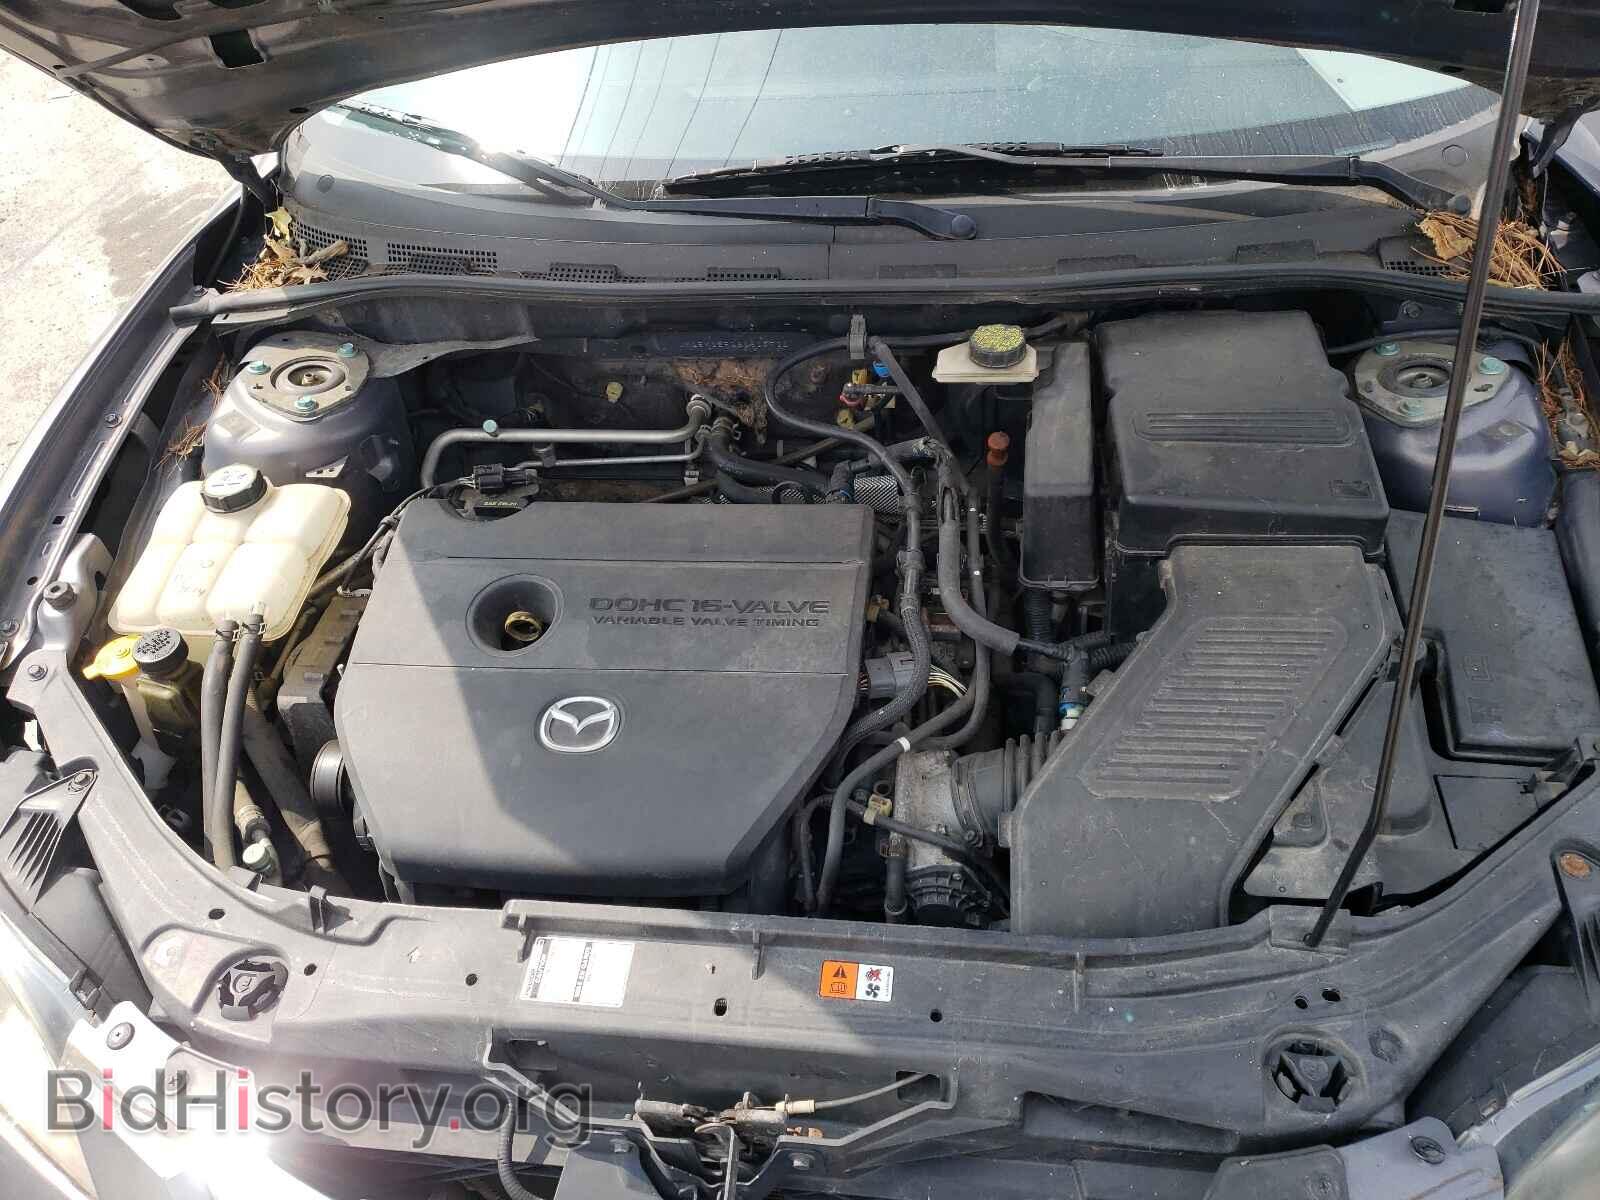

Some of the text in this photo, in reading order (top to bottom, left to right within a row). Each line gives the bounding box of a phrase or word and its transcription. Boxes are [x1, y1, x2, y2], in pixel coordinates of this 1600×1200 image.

[589, 597, 830, 614] DOHC 16-VALVE
[592, 615, 820, 628] VARIABLE VALVE TIMING
